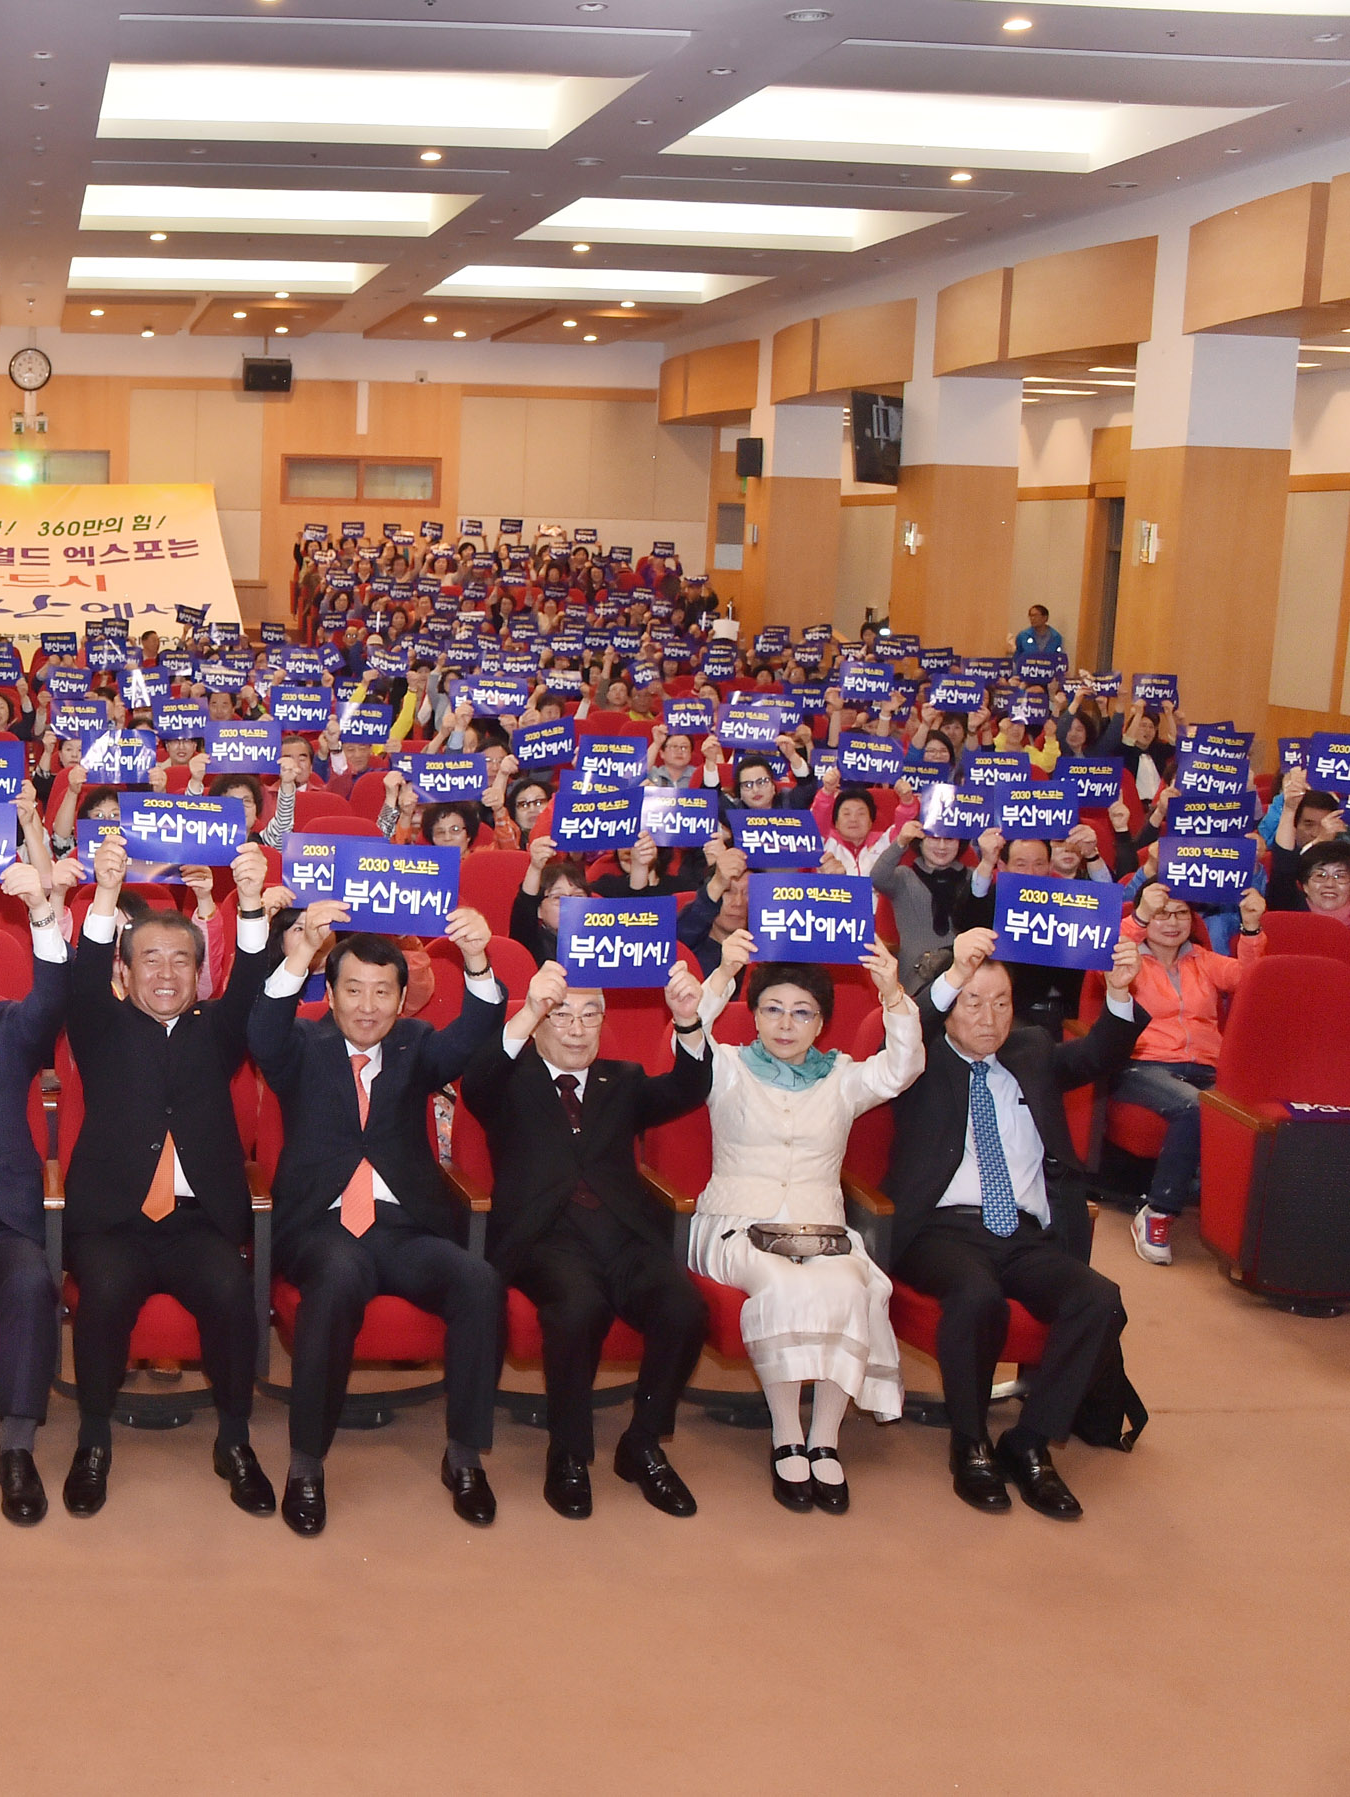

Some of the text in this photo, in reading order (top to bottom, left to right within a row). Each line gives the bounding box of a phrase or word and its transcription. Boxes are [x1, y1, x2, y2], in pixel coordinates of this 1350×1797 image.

[37, 517, 123, 537] 360만의
[132, 515, 166, 531] 힘!
[63, 538, 199, 566] 엑스포는
[473, 689, 524, 706] 부산에서!
[275, 704, 327, 721] 부산에서!
[220, 729, 238, 737] 2030
[721, 721, 775, 740] 부산에서!
[212, 742, 276, 761] 부산에서!
[519, 739, 572, 760] 부산에서!
[426, 762, 444, 770] 2030
[582, 757, 642, 777] 부산에서!
[843, 751, 899, 773] 부산에서!
[419, 773, 482, 791] 부산에서!
[970, 768, 1026, 785] 부산에서!
[1182, 771, 1242, 794] 부산에서!
[1011, 791, 1031, 799] 2030
[144, 799, 222, 812] 2030 엑스포는
[572, 803, 595, 812] 2030
[1185, 803, 1206, 811] 2030
[646, 811, 714, 833] 부산에서!
[746, 817, 768, 825] 2030
[1002, 805, 1072, 826] 부산에서!
[1175, 816, 1248, 834] 부산에서!
[131, 812, 237, 845] 부산에서!
[559, 817, 636, 838] 부산에서!
[742, 831, 815, 853] 부산에서!
[1177, 847, 1239, 859] 2030 엑스포는
[358, 857, 439, 875] 2030 엑스포는
[1167, 862, 1247, 888] 부산에서!
[344, 879, 451, 915] 부산에서!
[773, 887, 852, 902] 2030 엑스포는
[1019, 889, 1099, 909] 2030 엑스포는
[584, 912, 659, 927] 2030 엑스포는
[760, 909, 865, 942] 부산에서!
[1005, 909, 1111, 949] 부산에서!
[569, 935, 669, 967] 부산에서!
